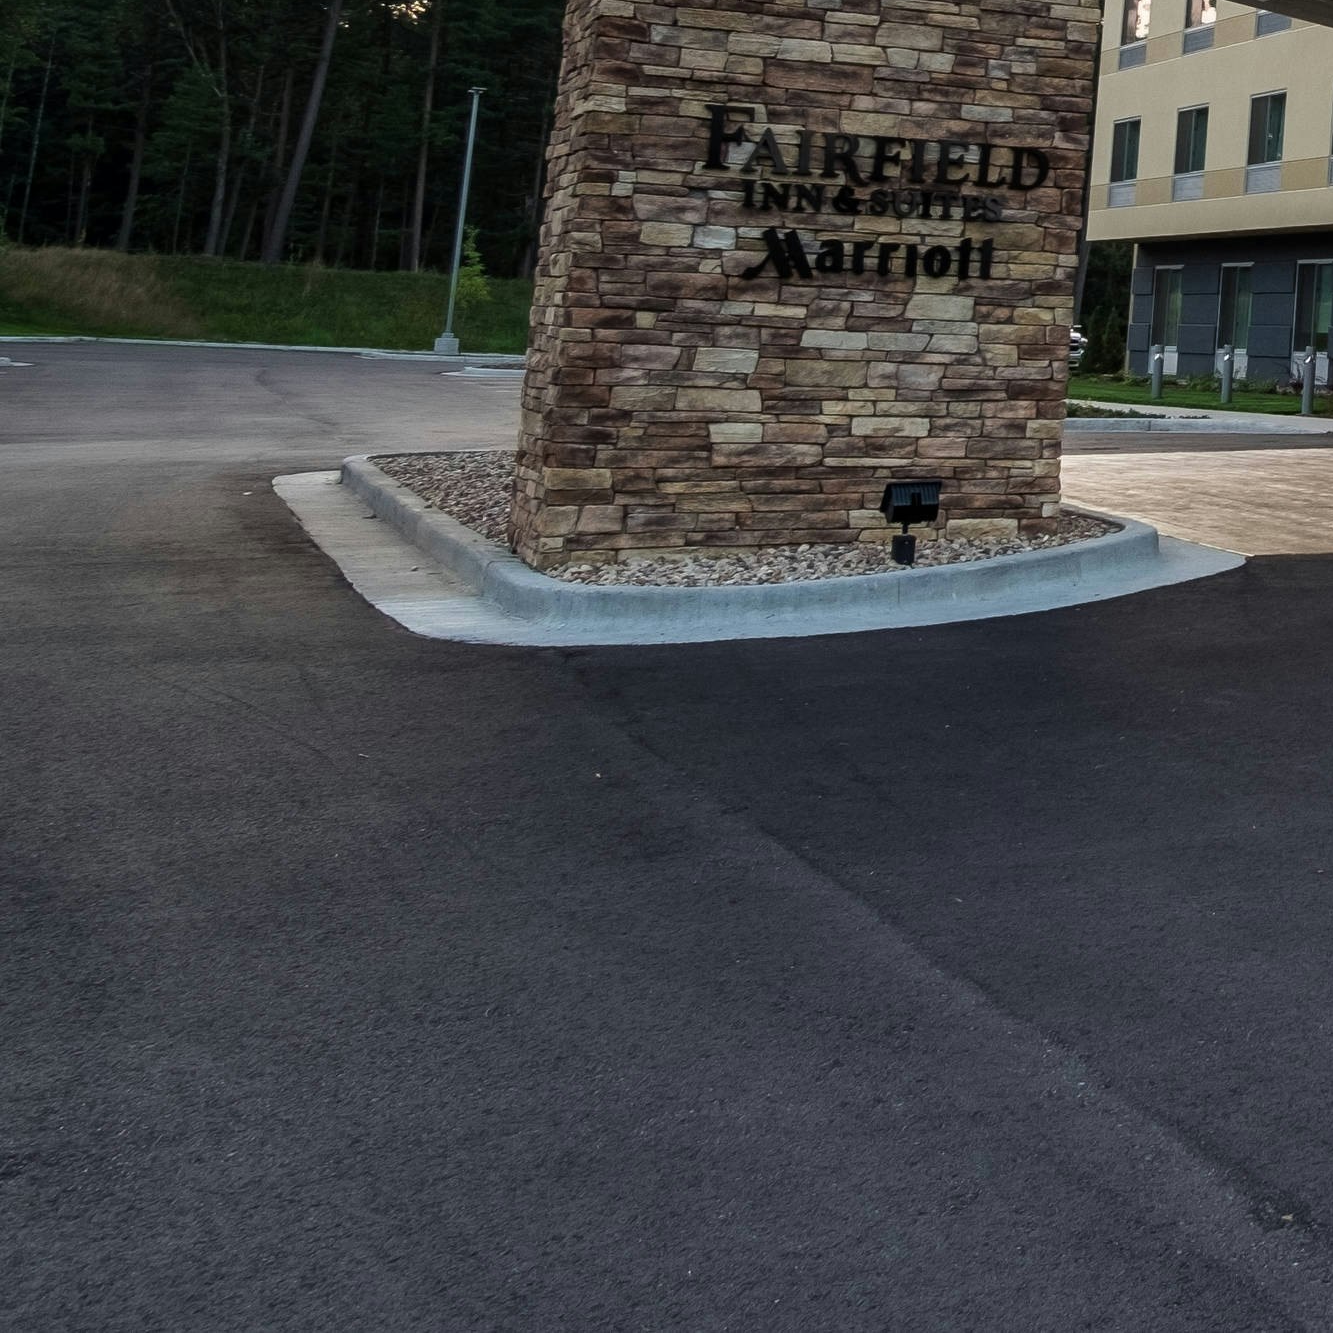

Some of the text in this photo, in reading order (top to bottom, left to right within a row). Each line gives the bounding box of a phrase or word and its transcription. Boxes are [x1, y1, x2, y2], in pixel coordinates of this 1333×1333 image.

[705, 104, 1051, 191] FAIRFIELD
[742, 181, 1002, 223] INN & SUITES
[741, 227, 994, 280] Marriott
